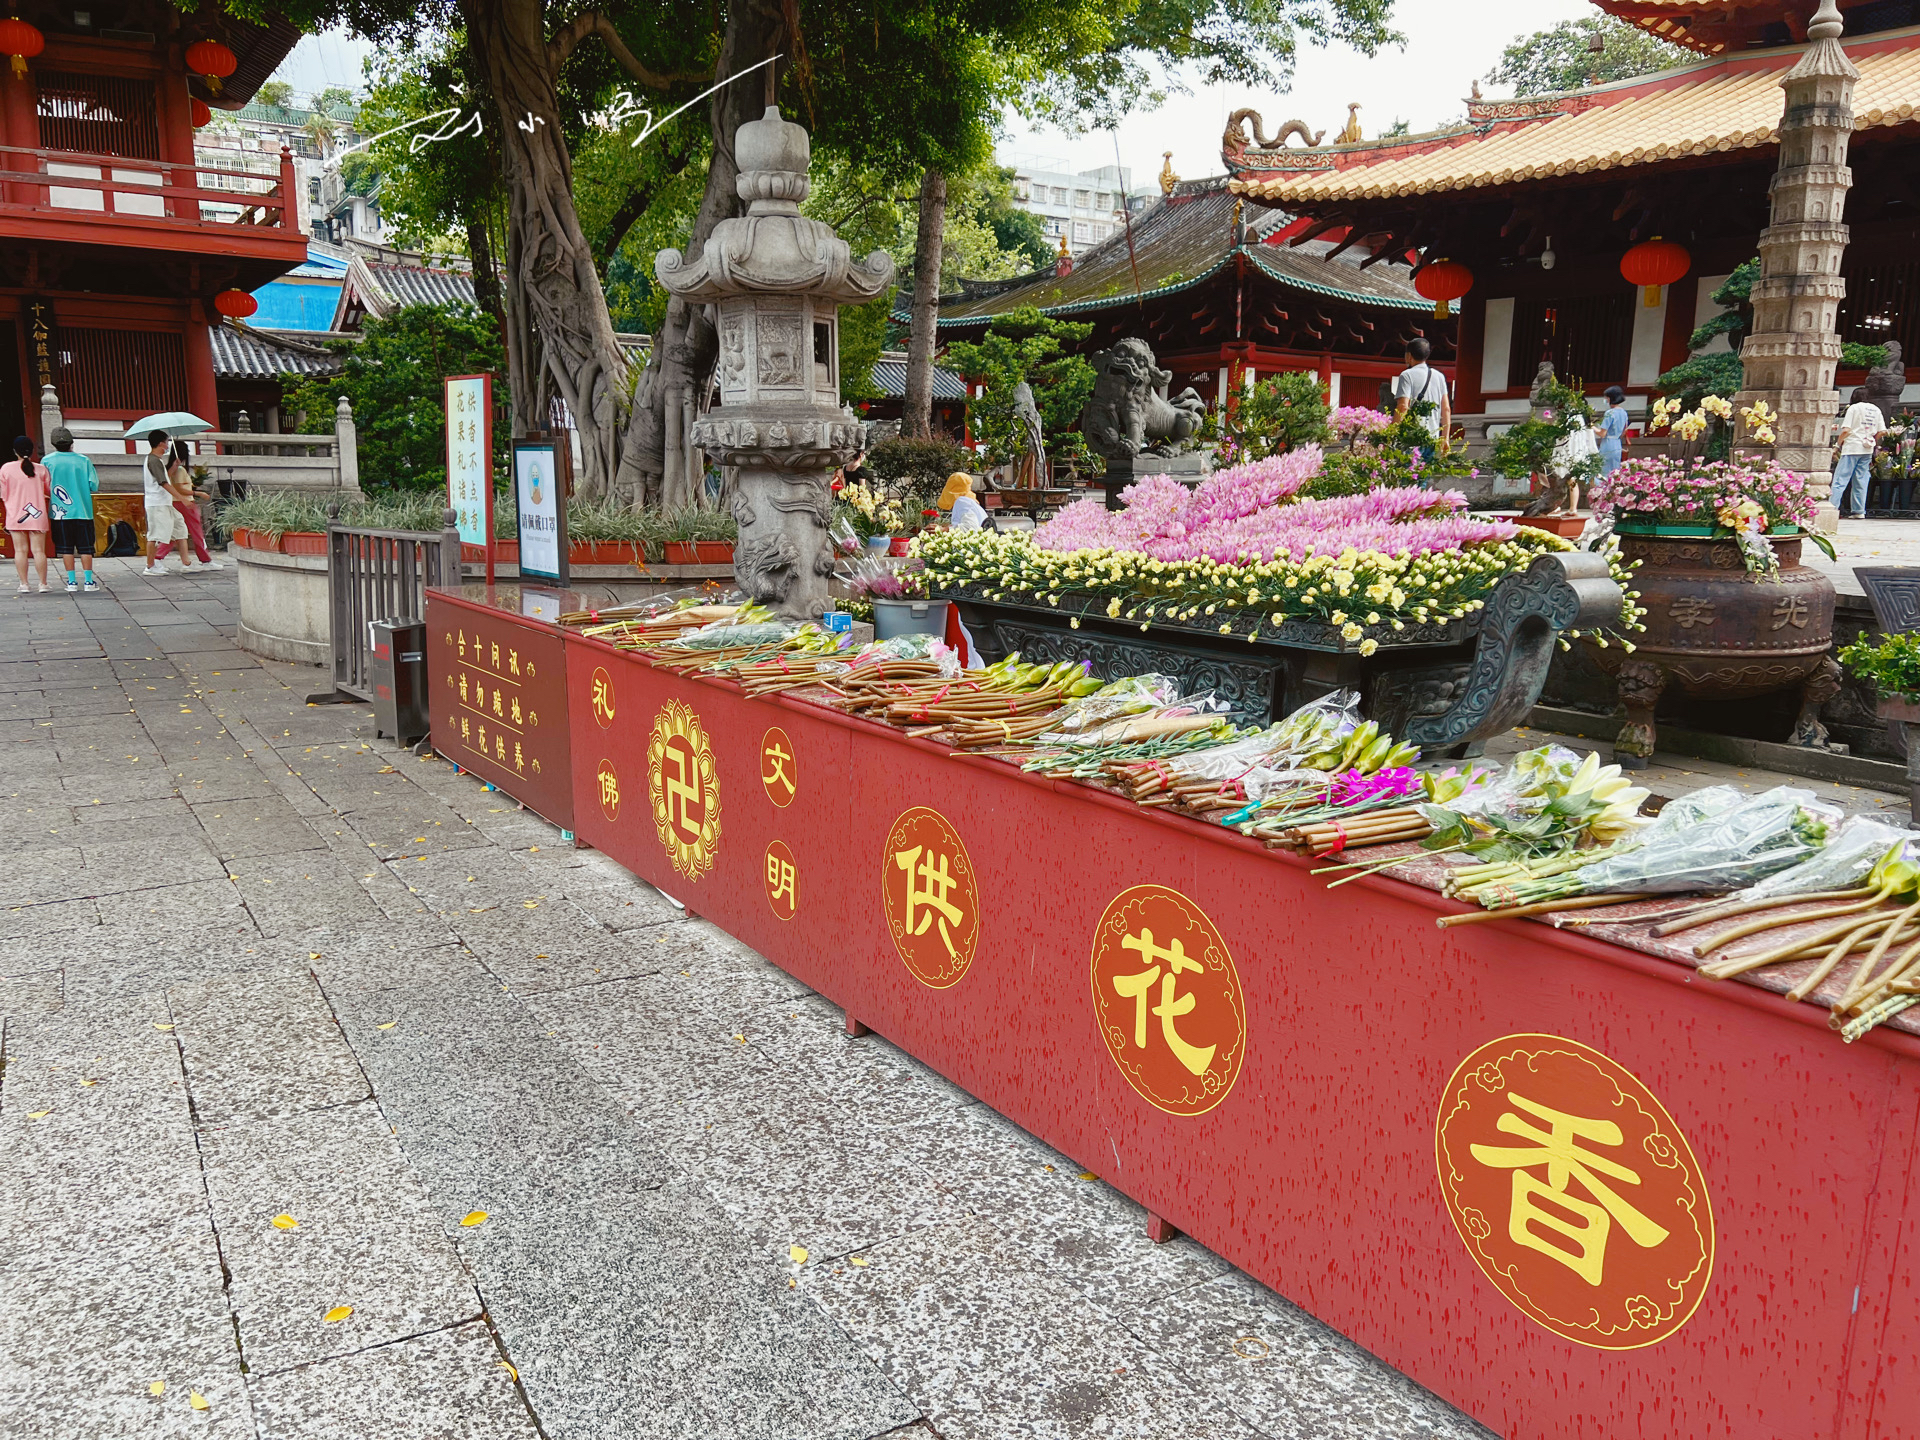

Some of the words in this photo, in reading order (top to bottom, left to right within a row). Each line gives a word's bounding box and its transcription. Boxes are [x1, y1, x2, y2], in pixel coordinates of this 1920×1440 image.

[467, 391, 479, 533] 供香不点香
[521, 513, 556, 532] 请佩戴口罩
[457, 628, 520, 677] 合十问讯
[458, 672, 524, 726] 请勿跪地
[461, 716, 525, 774] 鲜花供养
[895, 845, 964, 958] 供
[1112, 927, 1217, 1077] 花
[1470, 1091, 1670, 1287] 香
